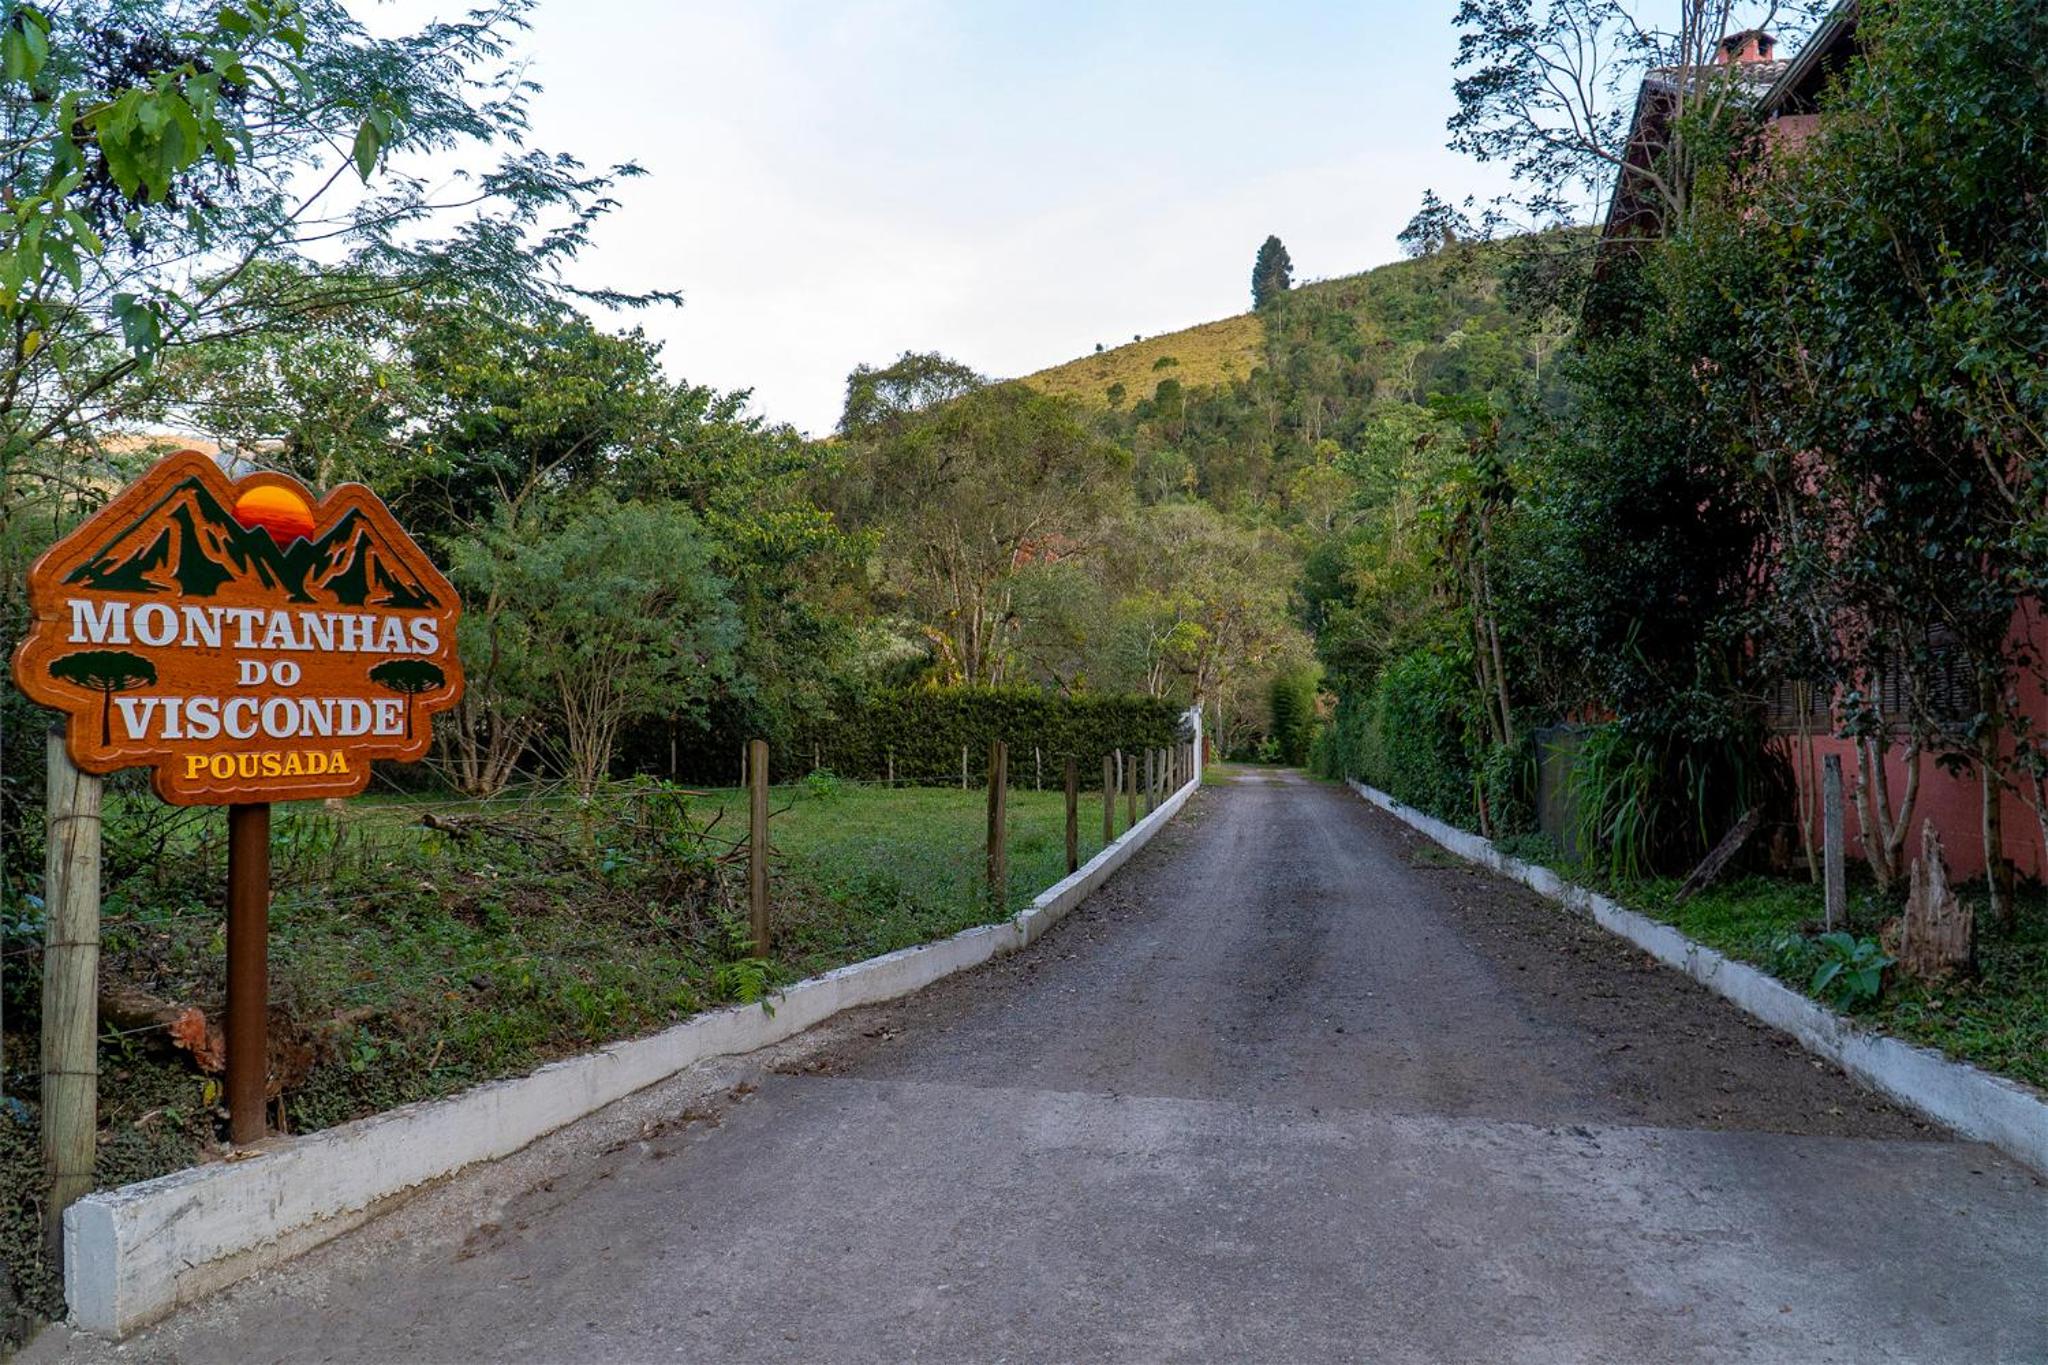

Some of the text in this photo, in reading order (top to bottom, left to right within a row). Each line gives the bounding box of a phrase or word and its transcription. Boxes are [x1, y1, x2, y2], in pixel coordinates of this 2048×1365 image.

[67, 599, 439, 655] MONTANHAS
[238, 660, 301, 686] DO
[114, 696, 404, 740] VISCONDE
[185, 750, 350, 780] POUSADA
